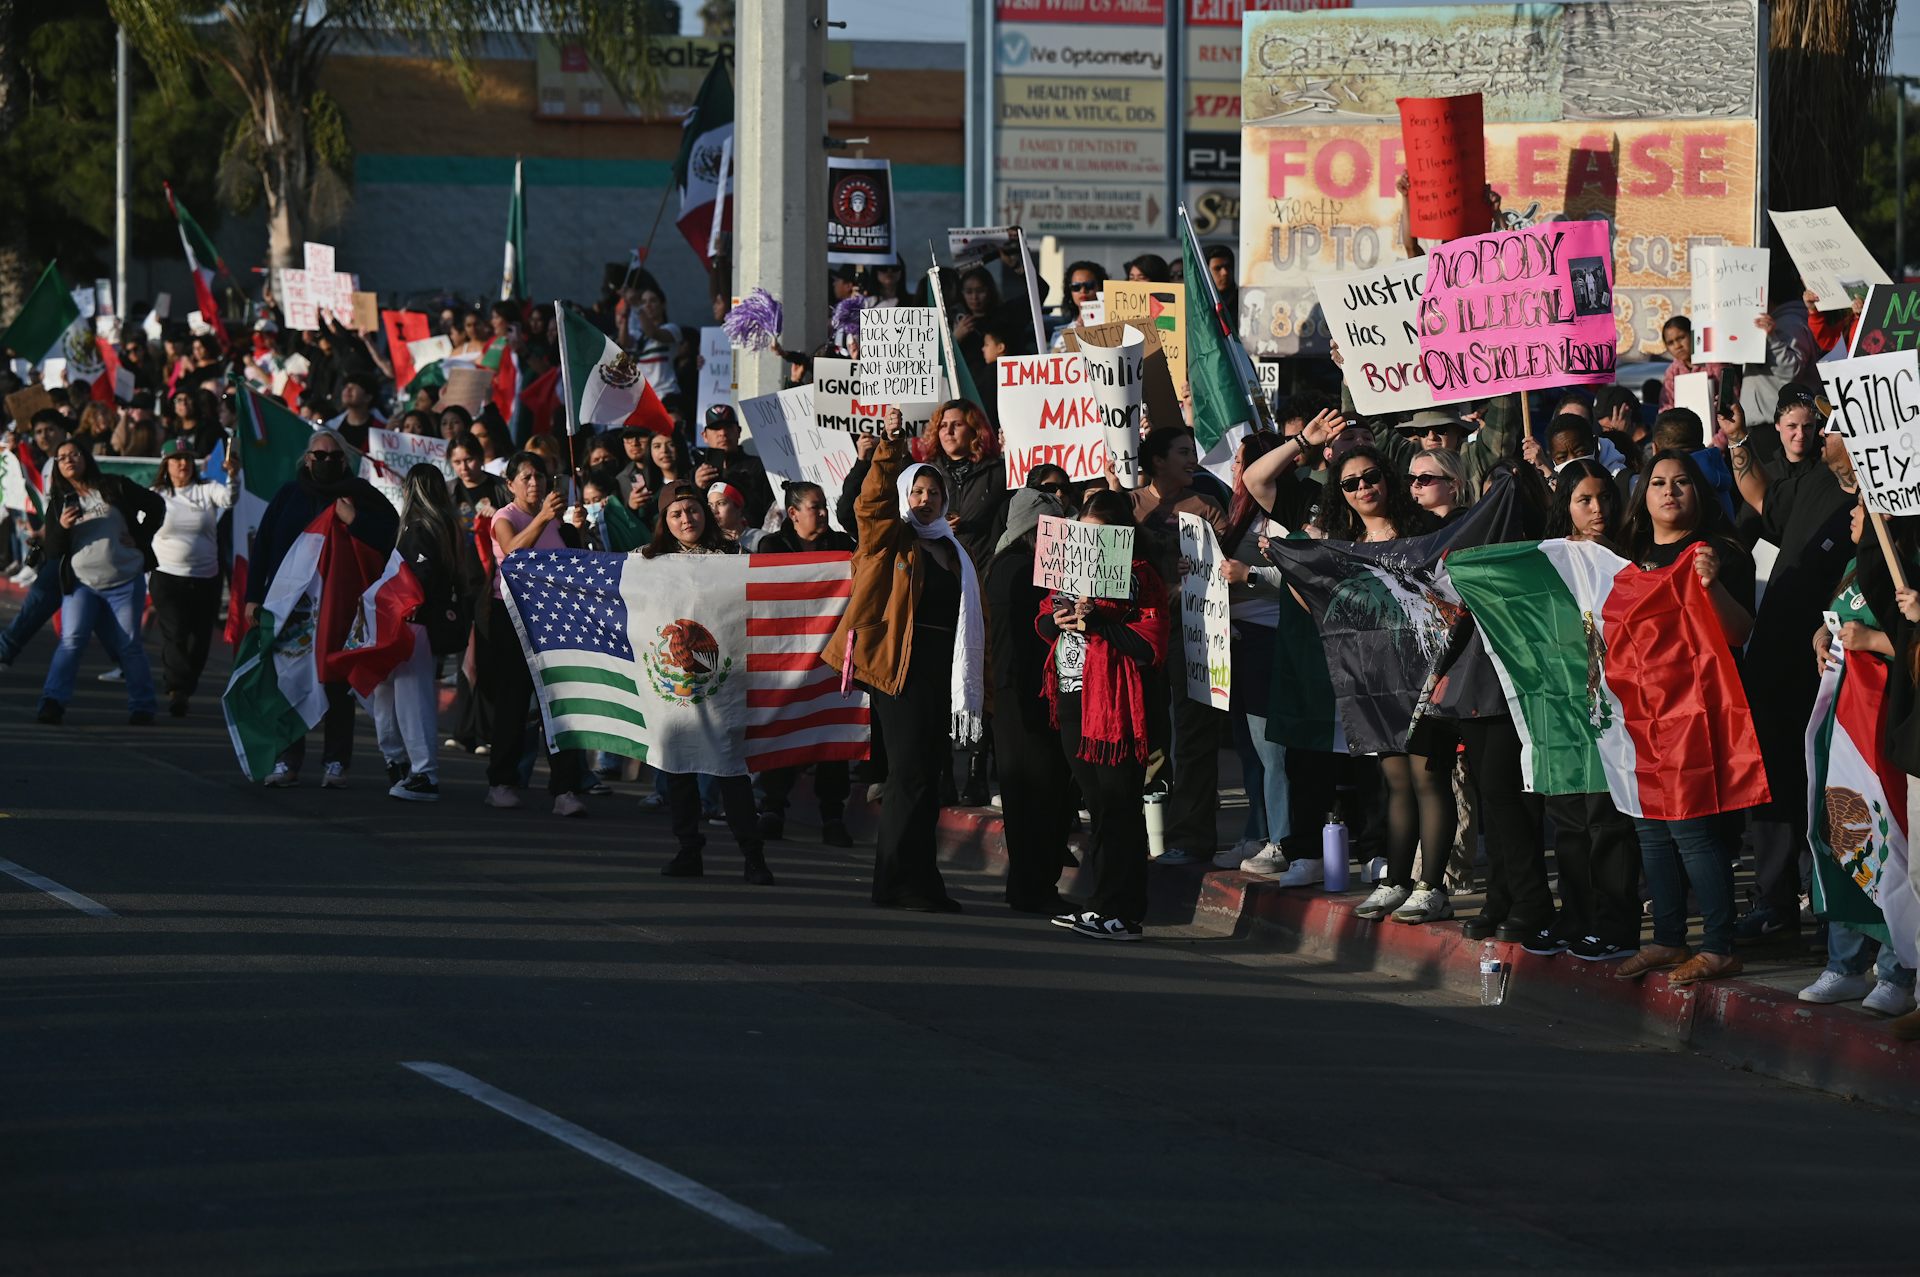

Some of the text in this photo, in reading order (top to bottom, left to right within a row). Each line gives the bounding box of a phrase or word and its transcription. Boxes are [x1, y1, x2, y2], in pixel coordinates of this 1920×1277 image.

[1061, 46, 1163, 69] Optometry
[1027, 85, 1132, 102] HEALTHY SMILE
[1126, 107, 1156, 122] DDS
[1019, 138, 1137, 154] FAMILY DENTISTRY
[1029, 206, 1063, 220] AUTO
[1067, 206, 1141, 221] INSURANCE
[1330, 225, 1381, 271] TO
[1430, 232, 1565, 292] NOBODY
[1115, 291, 1147, 313] FROM
[1456, 286, 1575, 333] ILLEGAL
[862, 309, 889, 325] YOU
[860, 342, 914, 359] CULTURE
[1425, 349, 1466, 391] ON
[1470, 341, 1566, 383] STOLEN
[411, 438, 447, 458] MAS
[1042, 521, 1135, 549] I DRINK MY
[1046, 541, 1105, 563] JAMAICA
[1040, 556, 1127, 580] WARM CAUSE
[1044, 573, 1081, 593] FUCK
